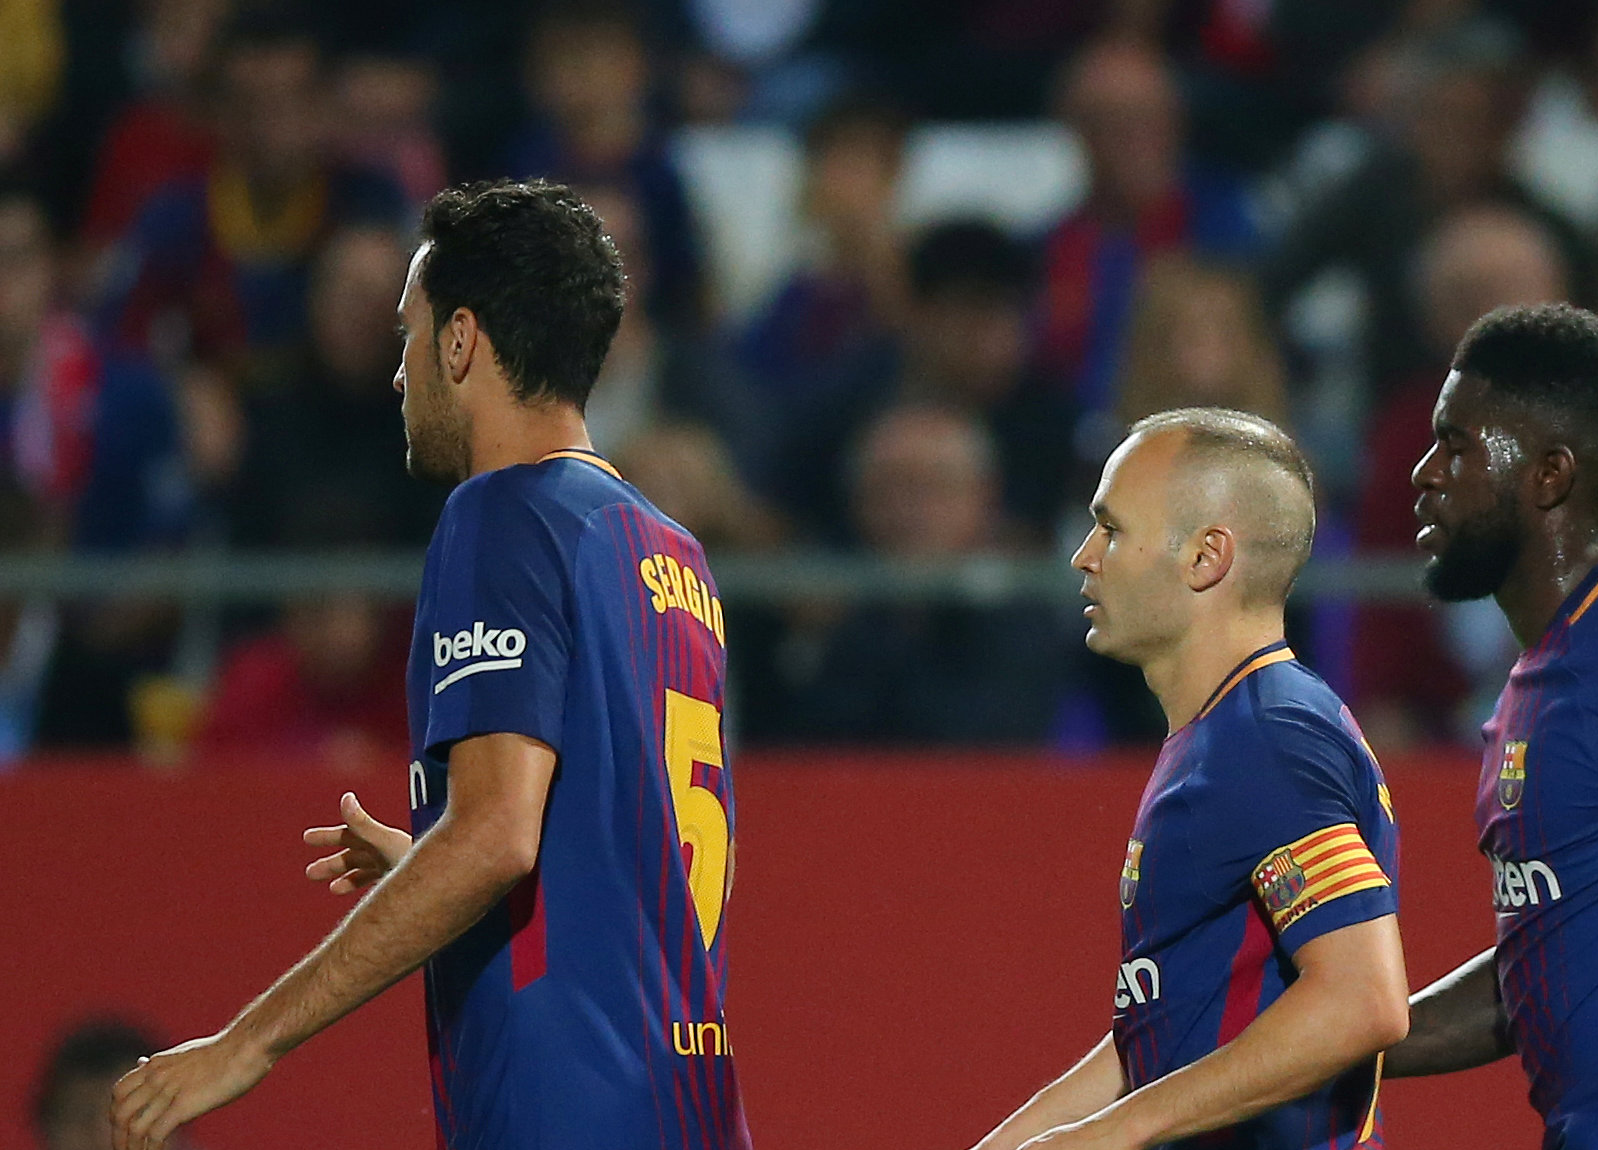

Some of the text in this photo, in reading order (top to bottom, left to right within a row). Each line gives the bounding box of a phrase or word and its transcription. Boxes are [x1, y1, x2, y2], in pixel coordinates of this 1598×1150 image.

[640, 553, 725, 649] SERGIO
[433, 621, 527, 668] beko
[664, 688, 729, 952] 5
[672, 1010, 734, 1056] uni
